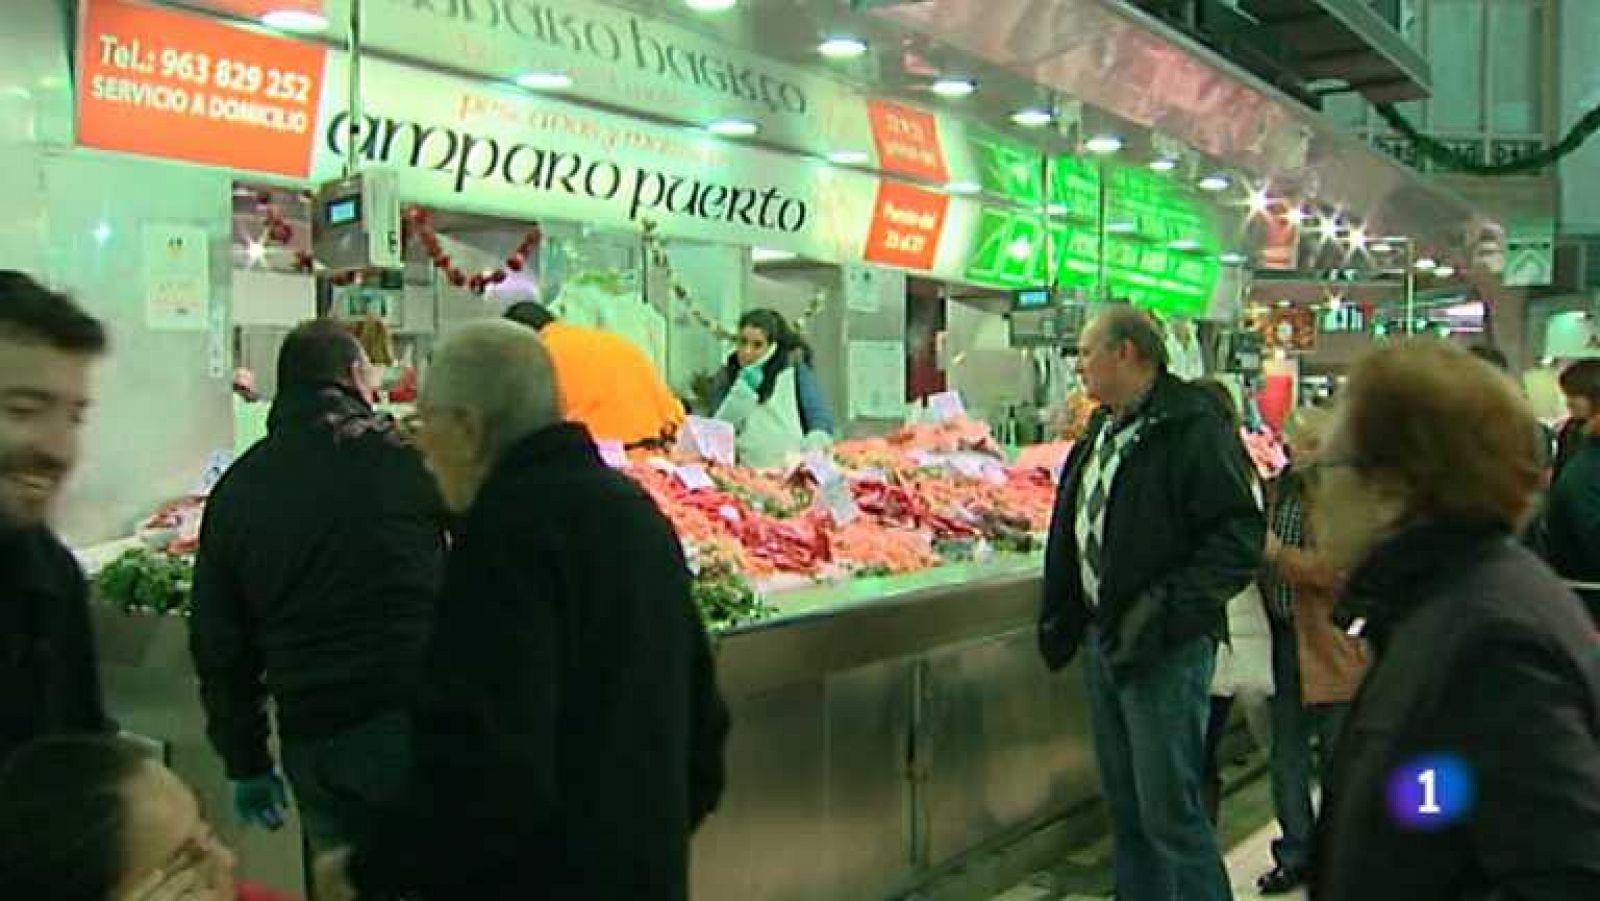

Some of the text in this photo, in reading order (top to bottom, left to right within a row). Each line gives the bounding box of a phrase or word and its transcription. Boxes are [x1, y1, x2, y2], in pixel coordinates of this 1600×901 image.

[90, 73, 309, 135] SERVICIO A DOMICILIO
[100, 33, 312, 104] Tel.: 963 829 252
[325, 109, 622, 201] amparo
[629, 166, 808, 235] puerto
